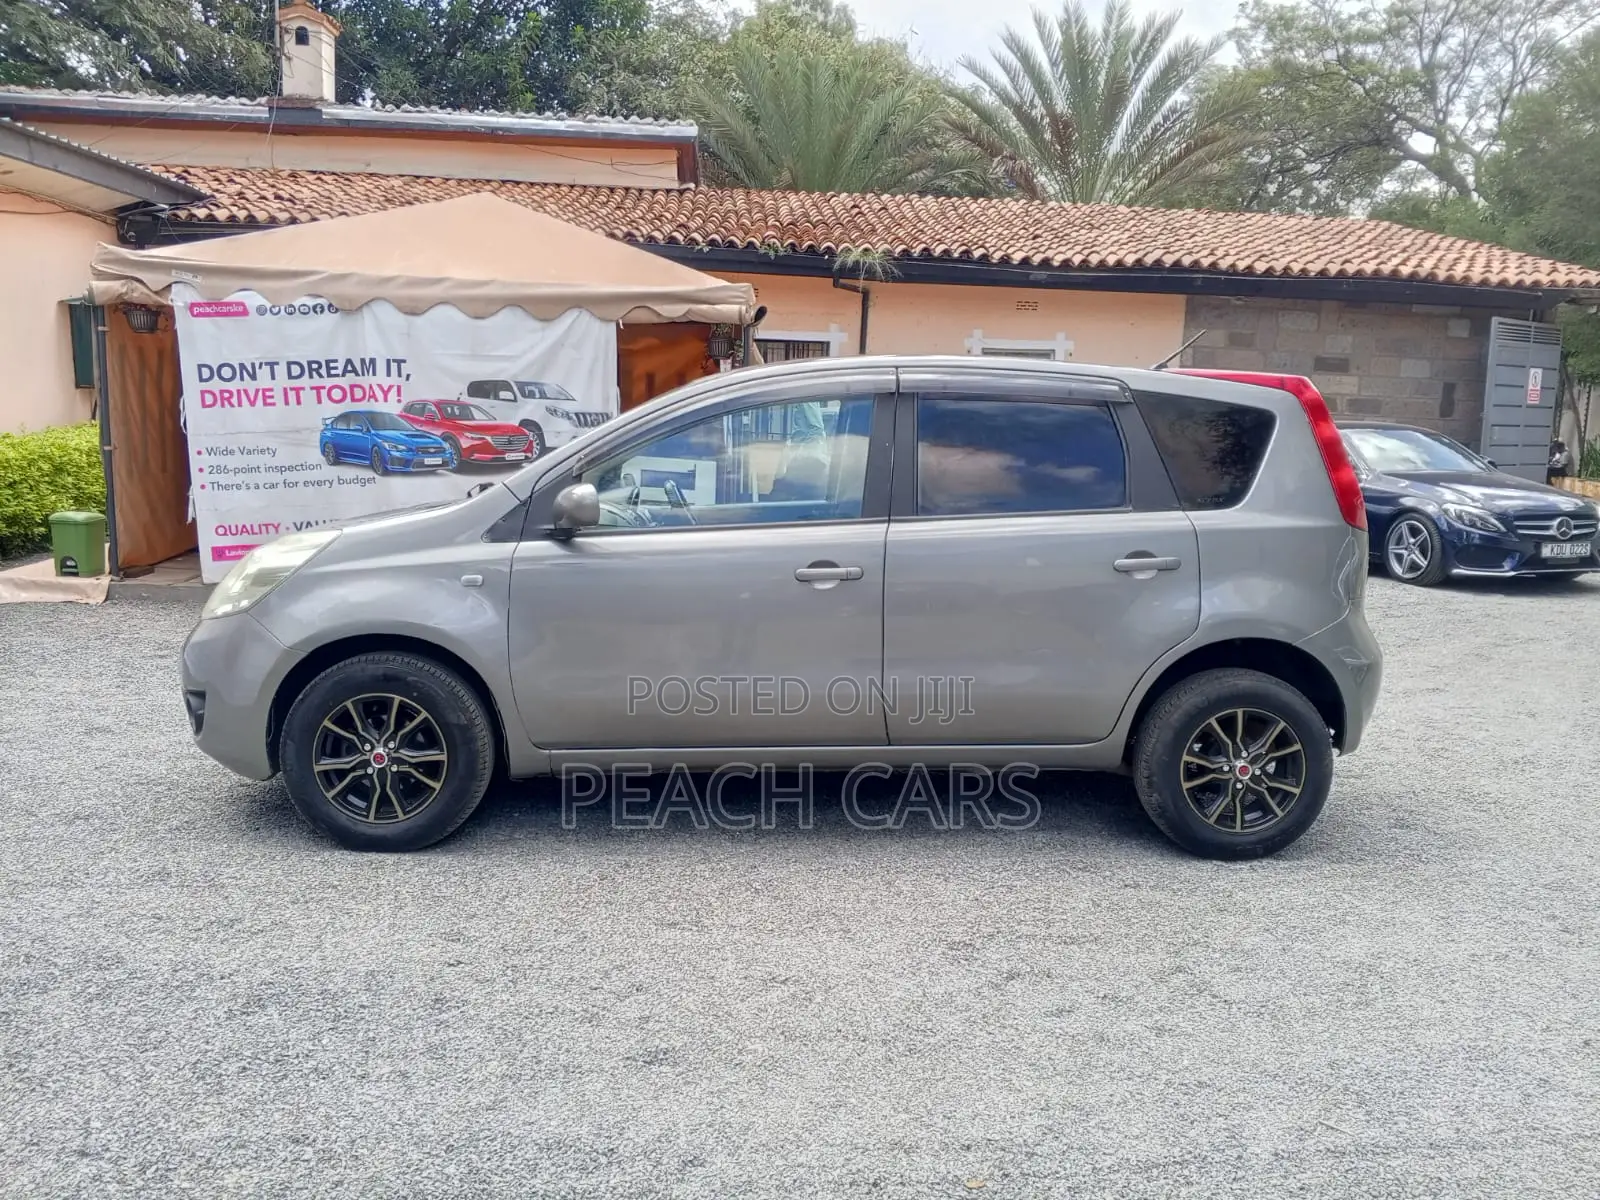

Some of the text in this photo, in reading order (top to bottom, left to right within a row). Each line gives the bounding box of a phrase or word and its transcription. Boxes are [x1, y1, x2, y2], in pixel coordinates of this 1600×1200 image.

[197, 357, 411, 383] DON'T DREAM IT,
[200, 383, 402, 409] DRIVE IT TODAY!
[205, 446, 277, 458] Wide Variety
[208, 461, 322, 476] 286-point inspection
[209, 480, 251, 492] There's
[263, 481, 280, 490] car
[282, 478, 299, 489] for
[303, 478, 334, 489] every
[337, 474, 377, 486] budget
[214, 522, 281, 537] QUALITY
[1550, 544, 1567, 556] KDU
